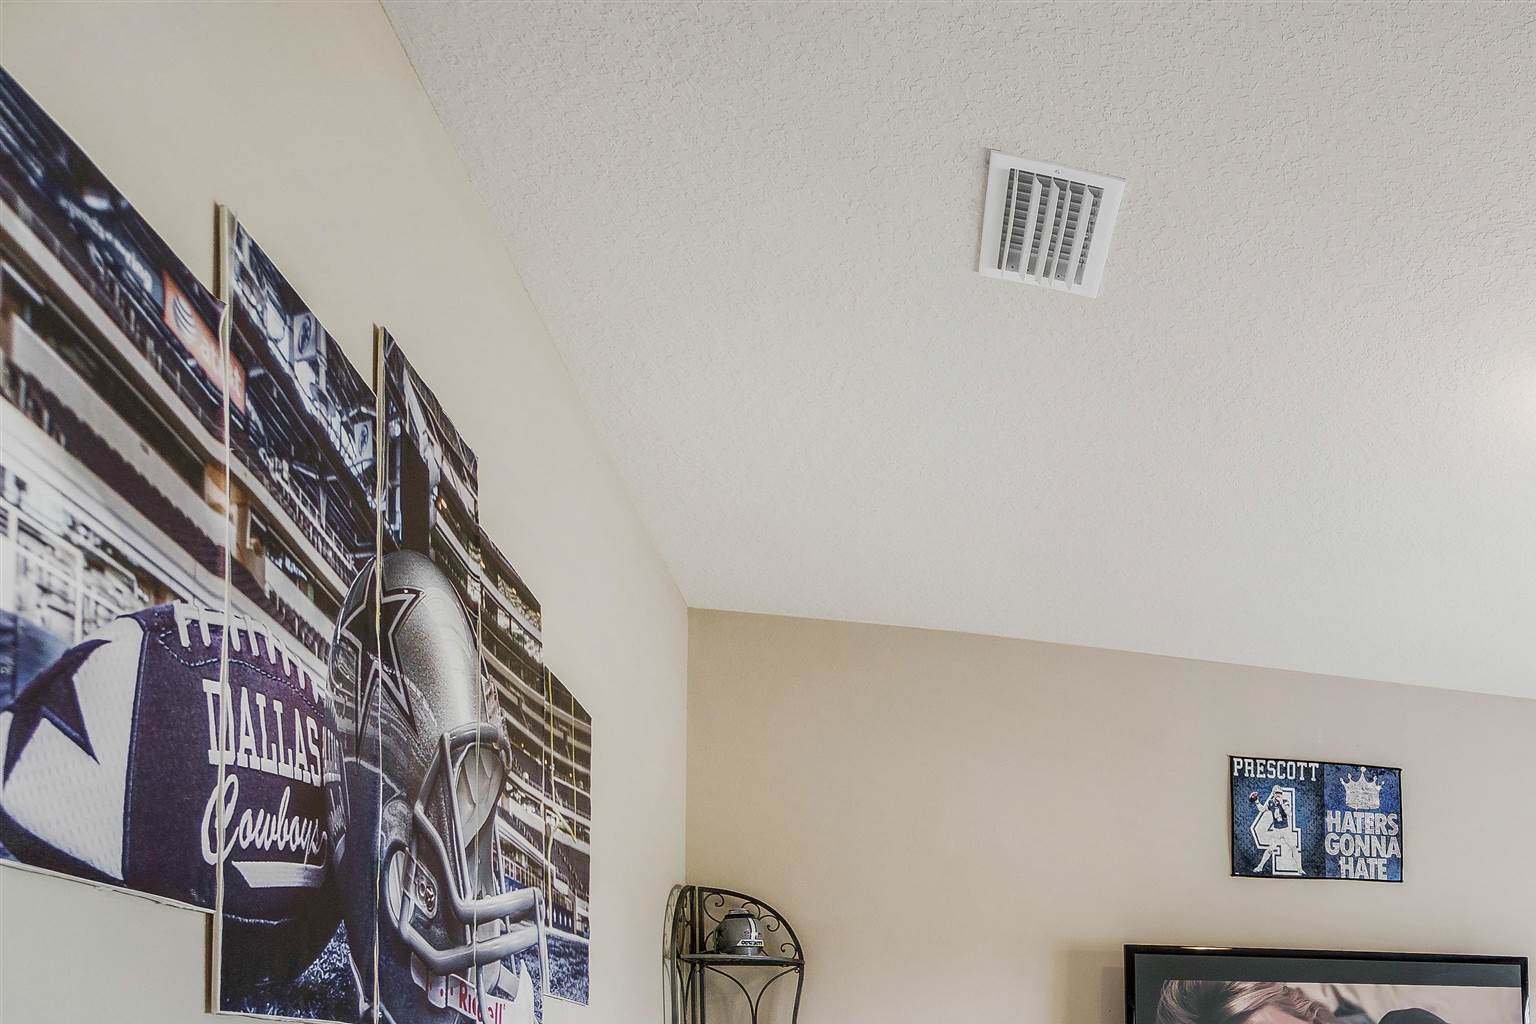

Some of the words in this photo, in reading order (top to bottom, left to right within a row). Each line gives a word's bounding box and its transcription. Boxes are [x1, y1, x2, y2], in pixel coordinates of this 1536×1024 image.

[202, 678, 322, 787] DALLAS
[1232, 757, 1319, 781] PRESCOTT
[201, 773, 328, 869] Cowboys
[1325, 810, 1399, 836] HATERS
[1325, 832, 1401, 859] GONNA
[1339, 856, 1388, 881] HATE
